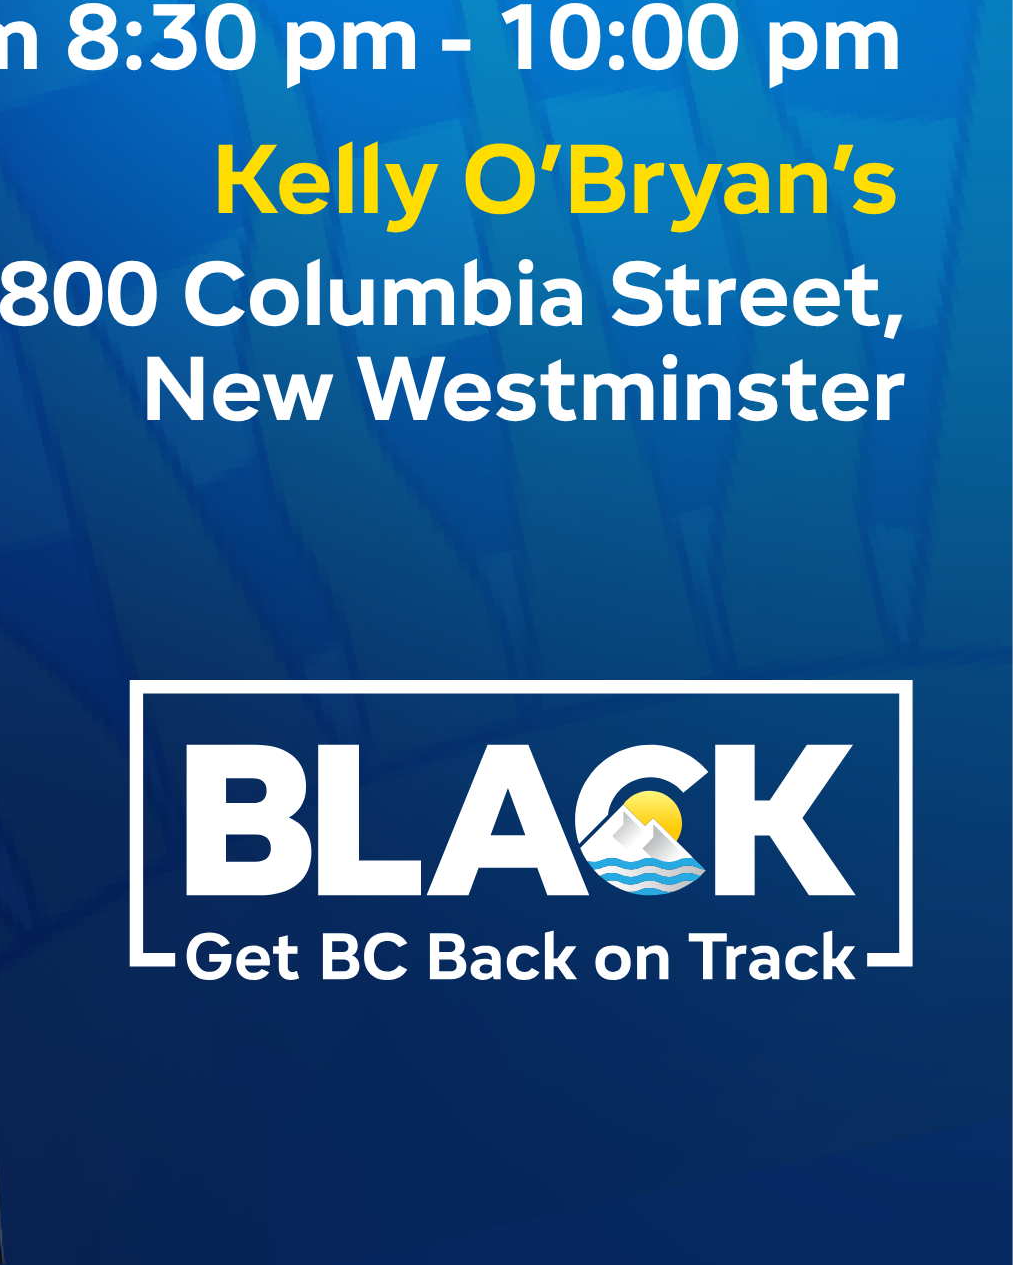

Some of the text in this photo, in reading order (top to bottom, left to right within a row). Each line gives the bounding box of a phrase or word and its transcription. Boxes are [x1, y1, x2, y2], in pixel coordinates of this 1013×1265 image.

[68, 3, 256, 70] 8:30
[287, 21, 415, 88] pm
[442, 39, 470, 51] -
[502, 3, 738, 70] 10:00
[770, 21, 897, 88] pm
[219, 142, 895, 232] Kelly O’Bryan’s
[0, 259, 902, 339] 800 Columbia Street,
[147, 354, 905, 421] New Westminster
[187, 745, 855, 895] BLACK
[187, 931, 855, 980] Get BC Back on Track
